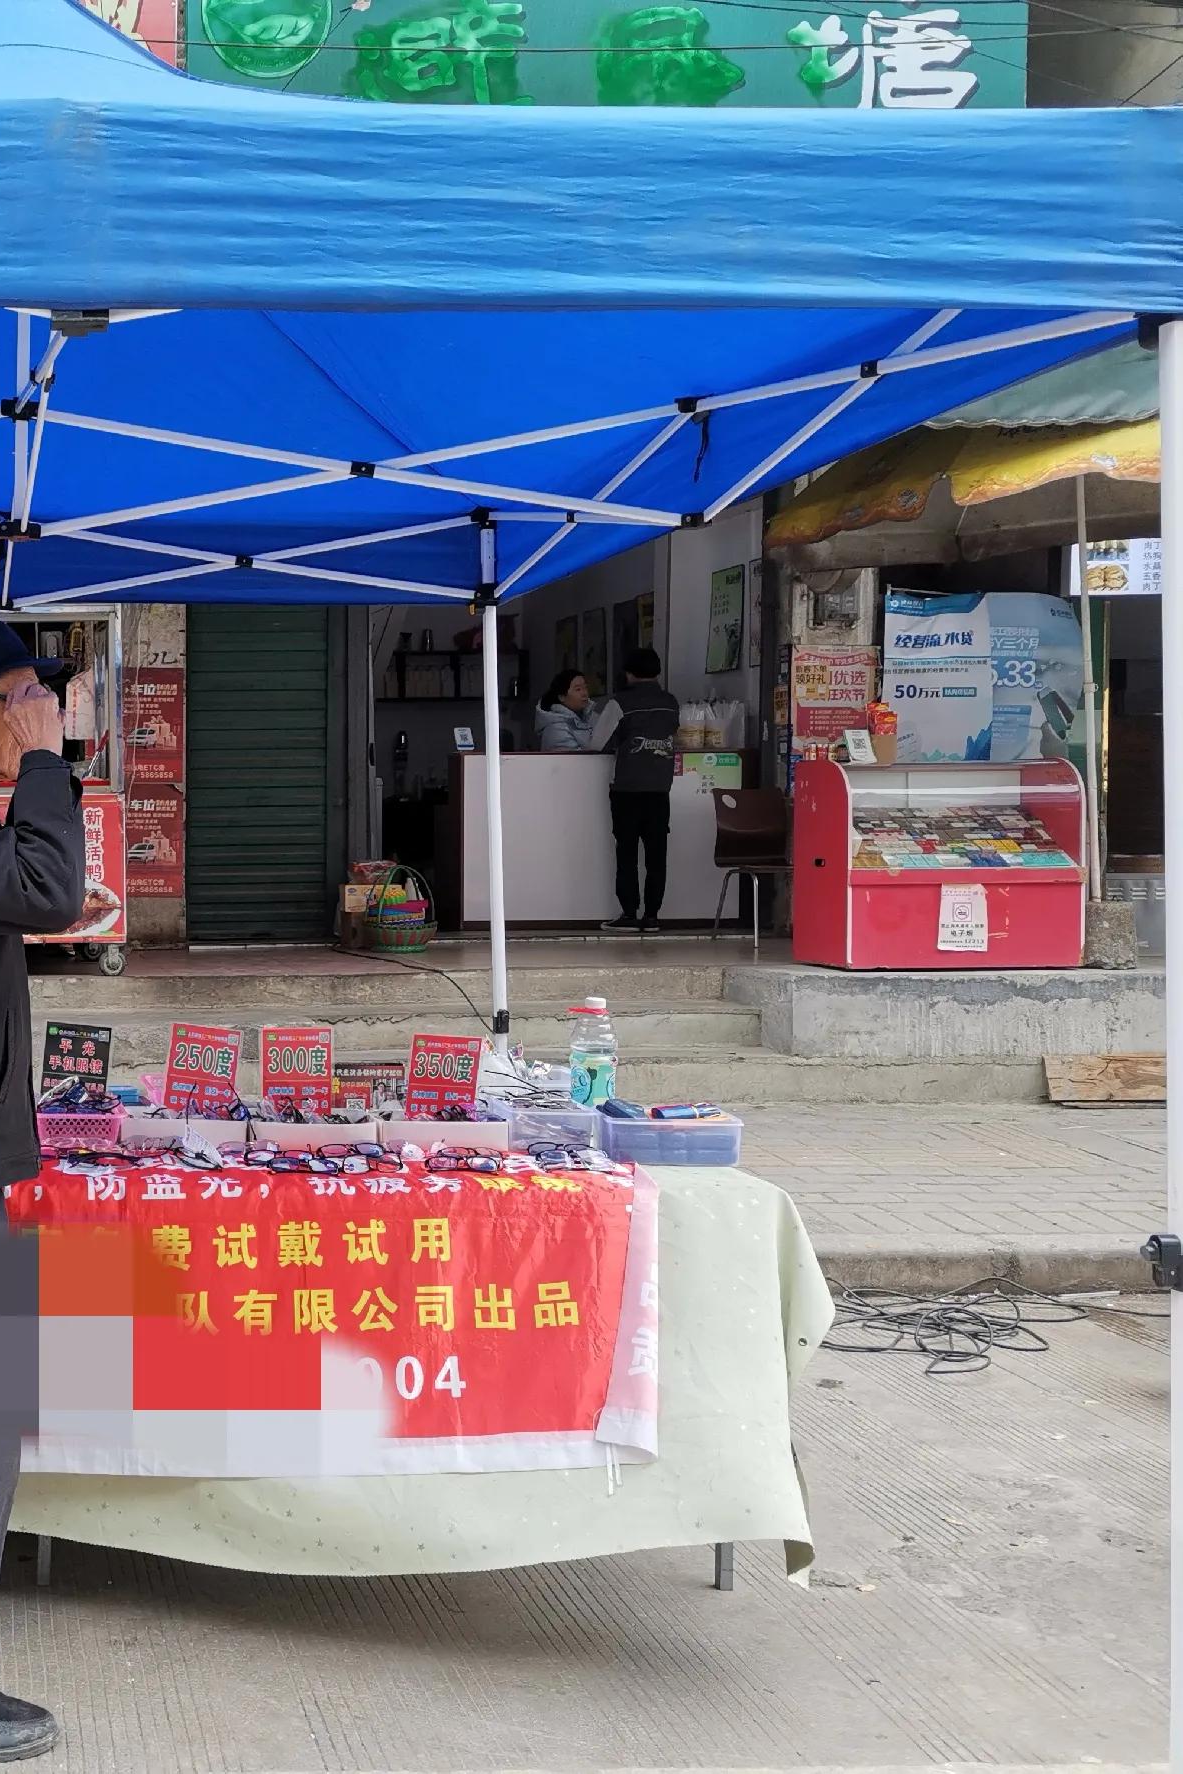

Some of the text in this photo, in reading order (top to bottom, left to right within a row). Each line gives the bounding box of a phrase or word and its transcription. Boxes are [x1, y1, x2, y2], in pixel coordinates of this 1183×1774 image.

[829, 670, 866, 686] 优选
[85, 806, 104, 882] 新鲜活鸭
[48, 1055, 104, 1075] 手机眼镜
[173, 1042, 235, 1080] 250度
[267, 1045, 328, 1077] 300度
[414, 1051, 474, 1083] 350度
